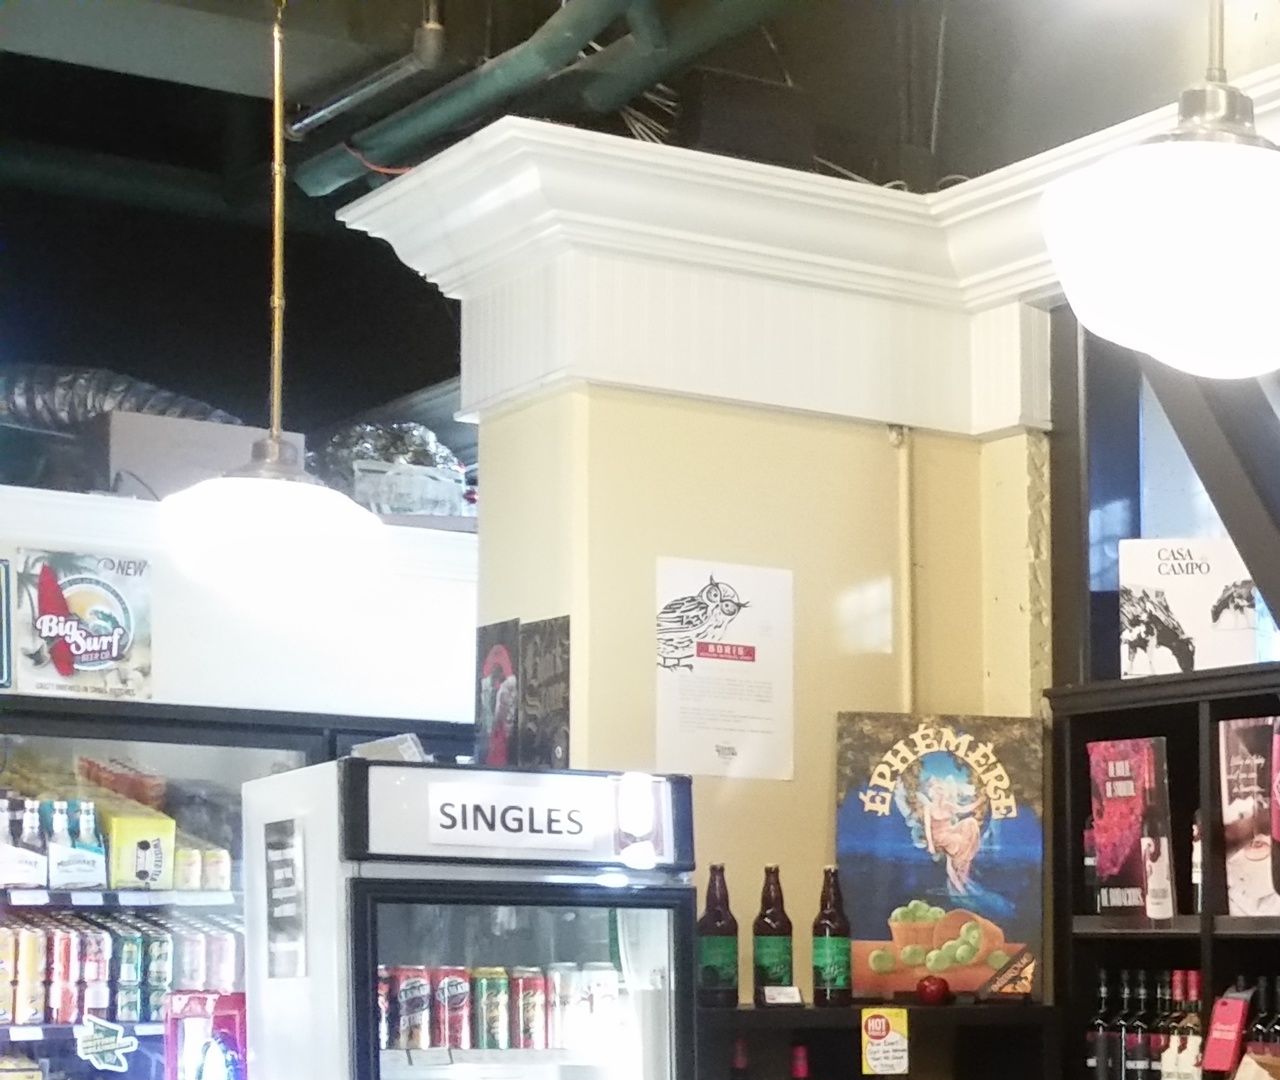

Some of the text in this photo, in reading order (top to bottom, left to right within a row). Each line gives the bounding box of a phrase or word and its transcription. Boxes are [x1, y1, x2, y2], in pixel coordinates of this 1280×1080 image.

[1157, 547, 1195, 561] CASA
[116, 559, 148, 577] NEW
[1157, 561, 1211, 576] CAMPO
[36, 615, 78, 643] Big
[70, 627, 124, 659] Surf
[438, 802, 584, 836] SINGLES
[867, 1017, 886, 1030] HOT
